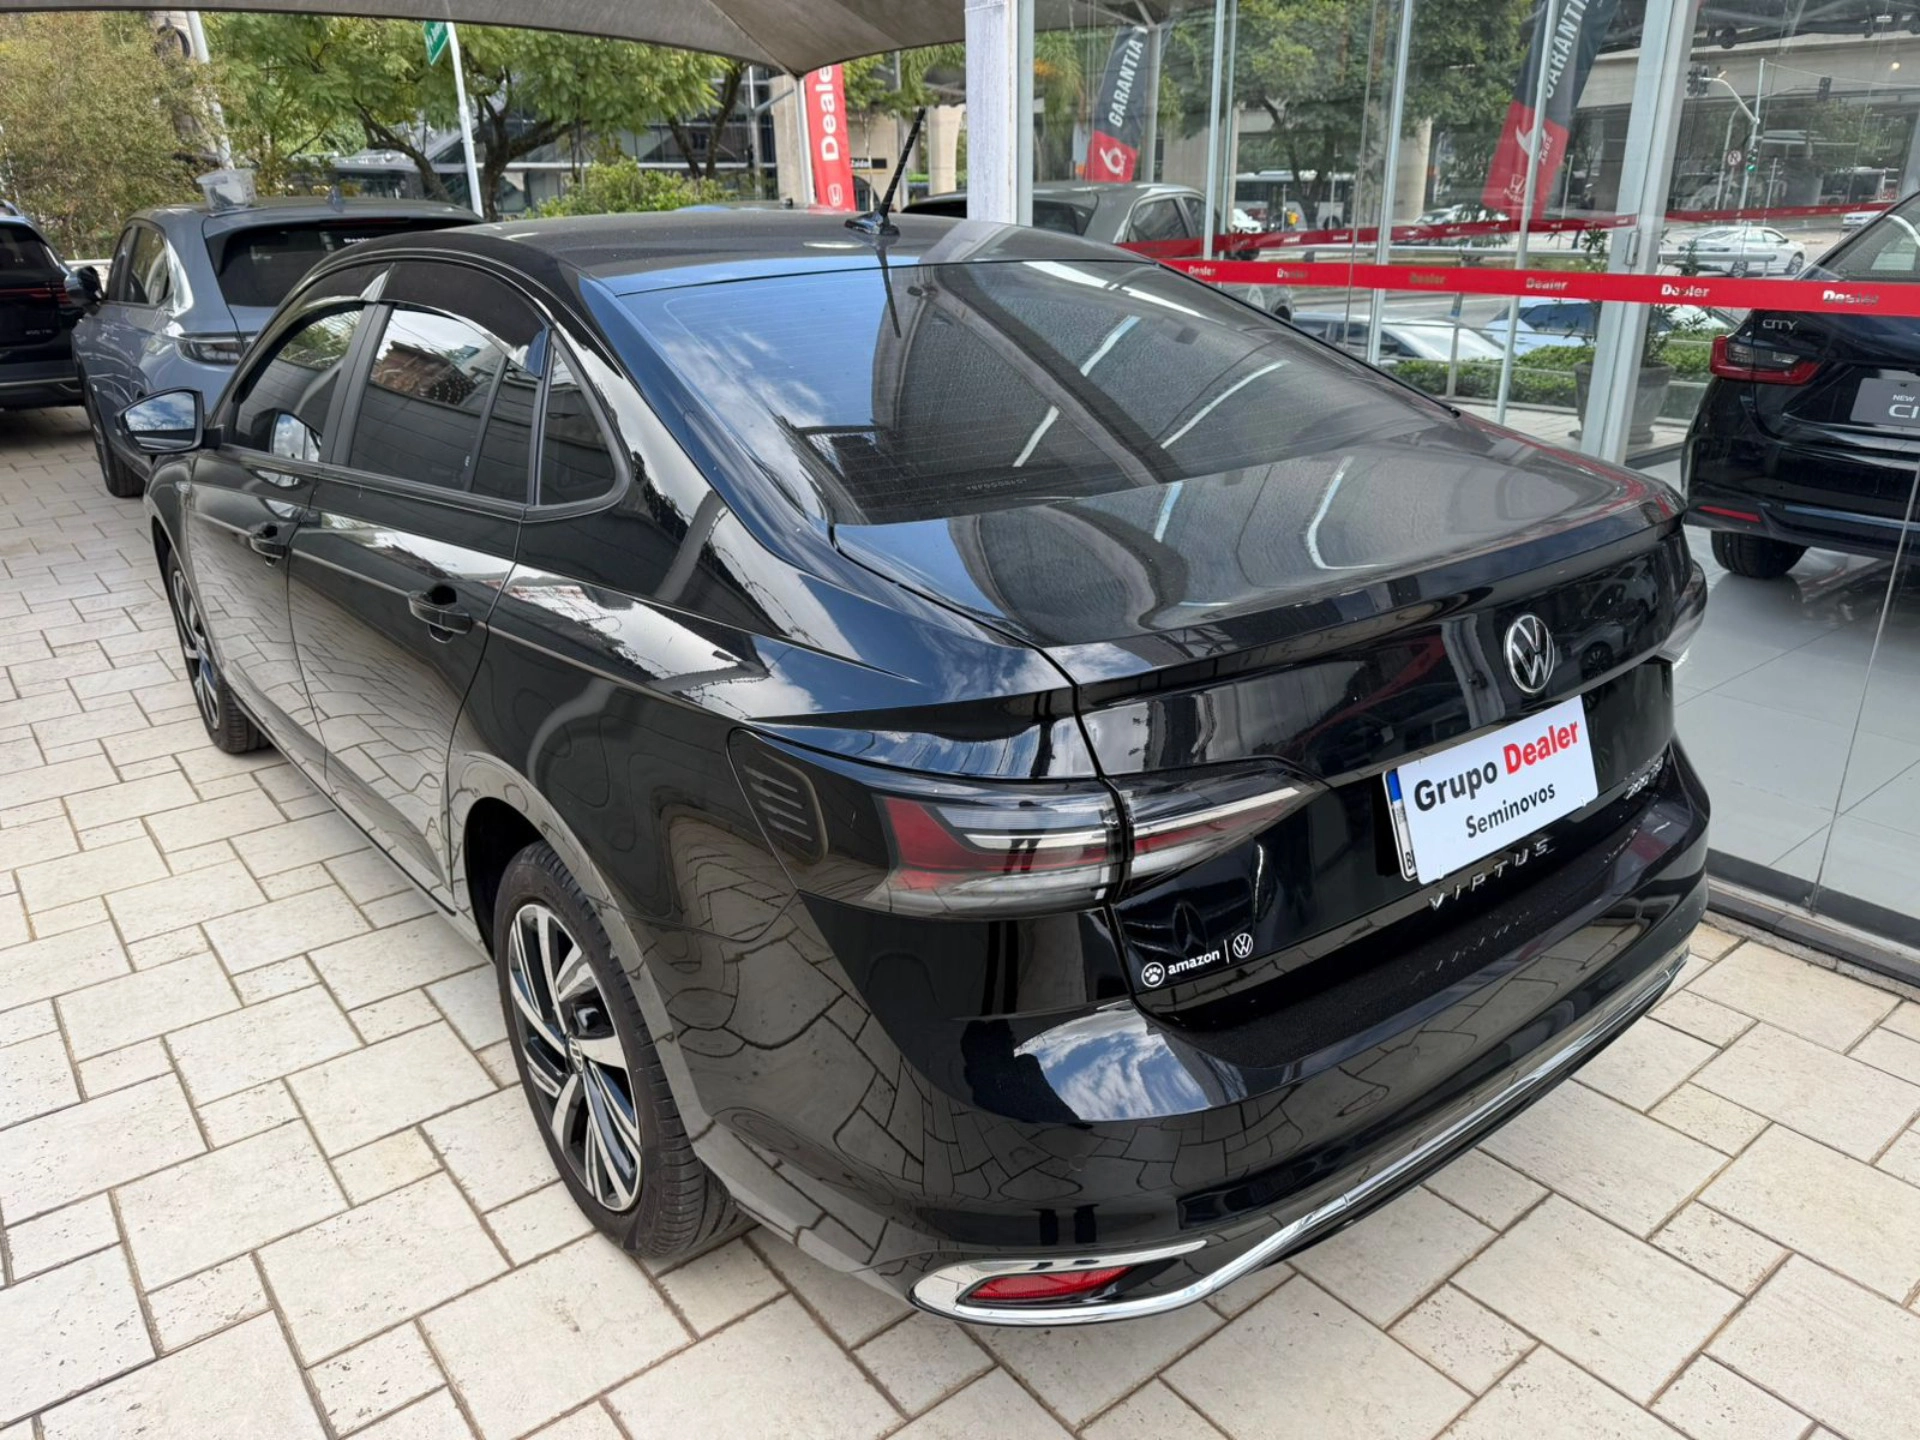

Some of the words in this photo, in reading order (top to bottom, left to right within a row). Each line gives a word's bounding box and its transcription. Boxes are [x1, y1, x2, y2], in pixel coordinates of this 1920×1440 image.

[1108, 38, 1144, 128] GARANTIA
[1526, 277, 1568, 291] Dealer
[1661, 283, 1710, 297] Dealer
[1822, 289, 1879, 305] Dealer
[1762, 318, 1798, 331] CITY
[1892, 394, 1916, 402] NEW
[1414, 761, 1498, 812] Grupo
[1503, 720, 1579, 775] Dealer
[1466, 783, 1556, 839] Seminovos
[1167, 950, 1220, 975] amazon
